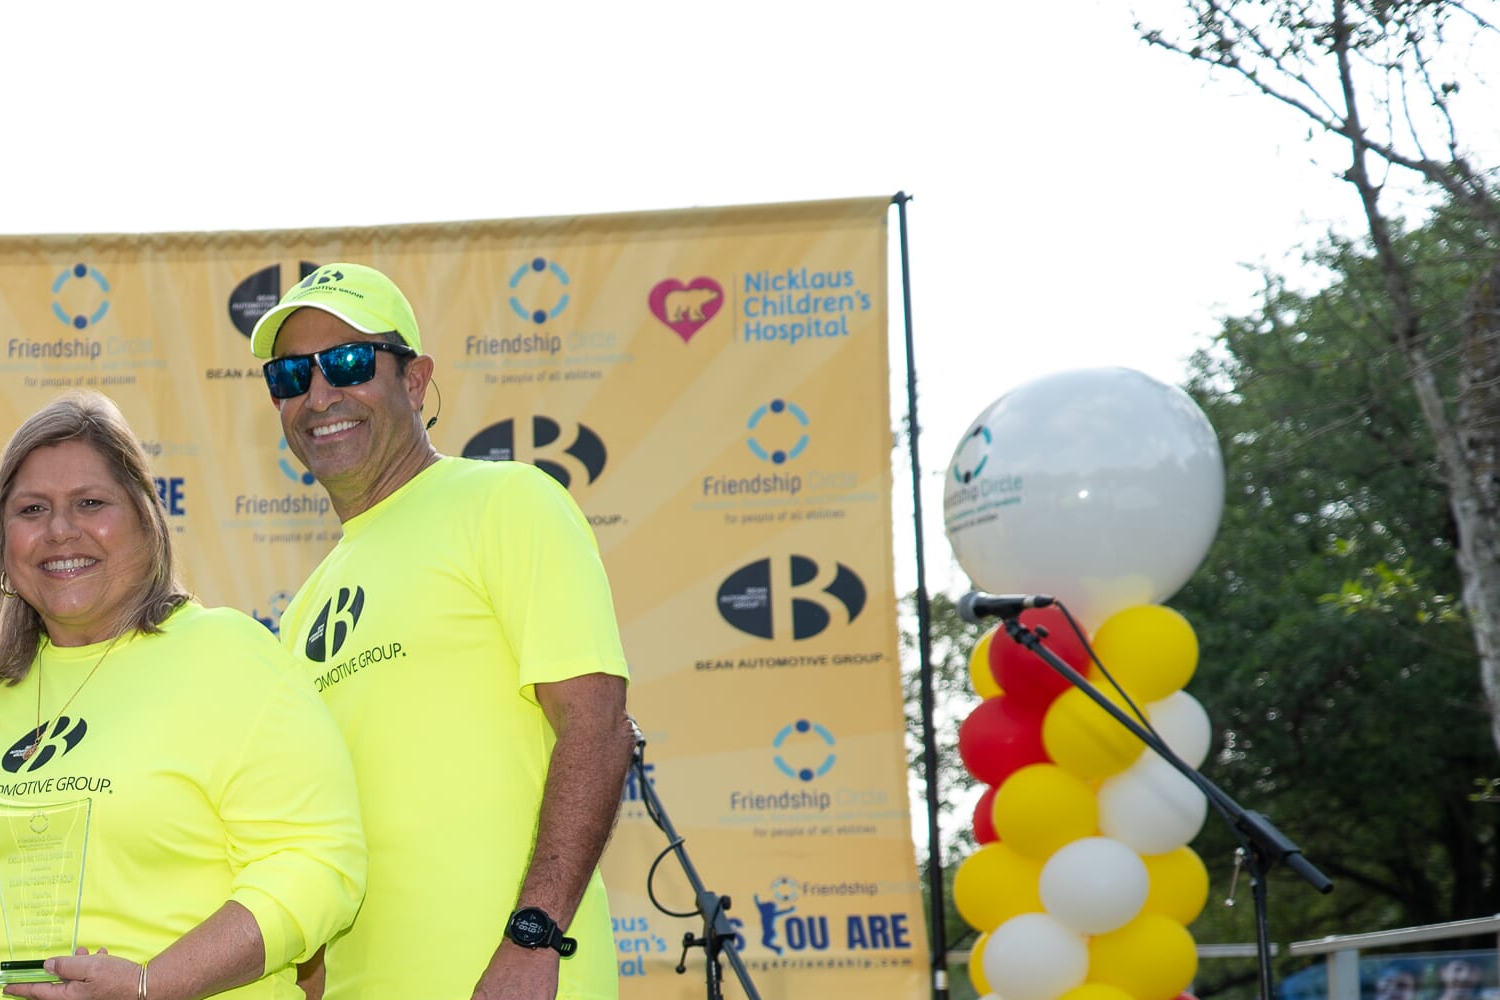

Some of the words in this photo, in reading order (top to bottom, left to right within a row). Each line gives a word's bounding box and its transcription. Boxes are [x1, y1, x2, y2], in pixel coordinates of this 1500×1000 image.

[744, 267, 854, 293] Nicklaus
[743, 289, 871, 319] Children's
[744, 314, 850, 345] Hospital
[8, 336, 102, 360] Friendship
[466, 331, 562, 356] Friendship
[703, 471, 802, 496] Friendship
[235, 493, 330, 516] Friendship
[314, 657, 359, 693] OMOTIVE
[695, 659, 733, 671] BEAN
[738, 654, 828, 669] AUTOMOTIVE
[730, 788, 831, 811] Friendship
[847, 913, 912, 950] ARE
